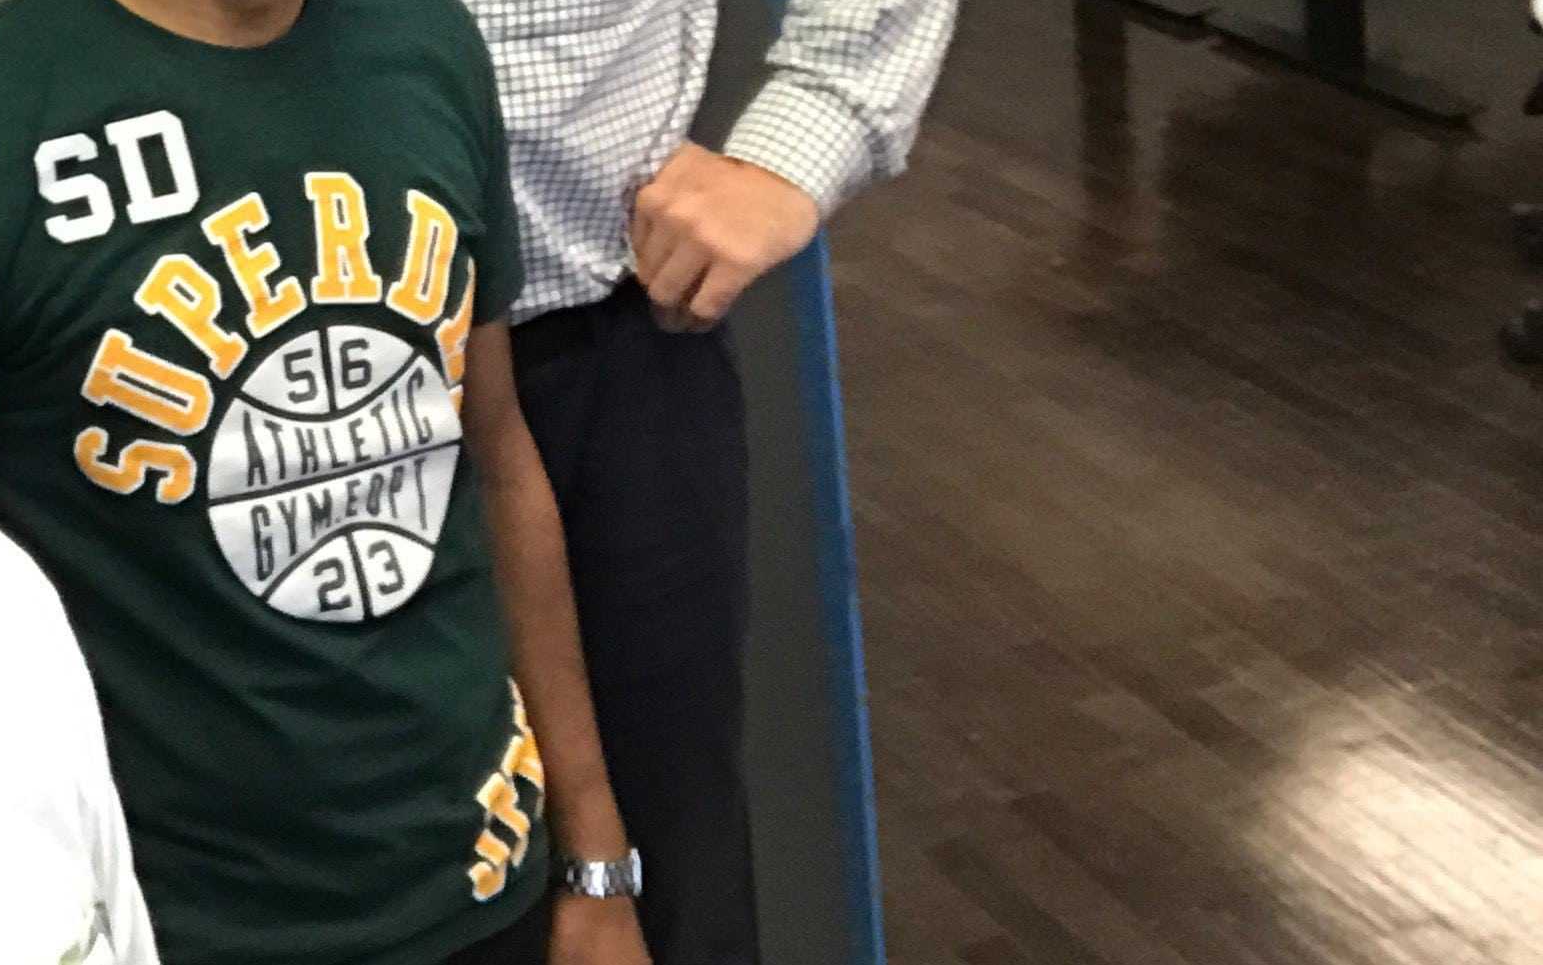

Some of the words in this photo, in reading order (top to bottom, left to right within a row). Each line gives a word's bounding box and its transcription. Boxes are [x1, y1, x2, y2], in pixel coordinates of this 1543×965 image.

[33, 110, 200, 243] SD
[74, 171, 475, 505] SUPERD
[243, 367, 434, 487] ATHLETIC
